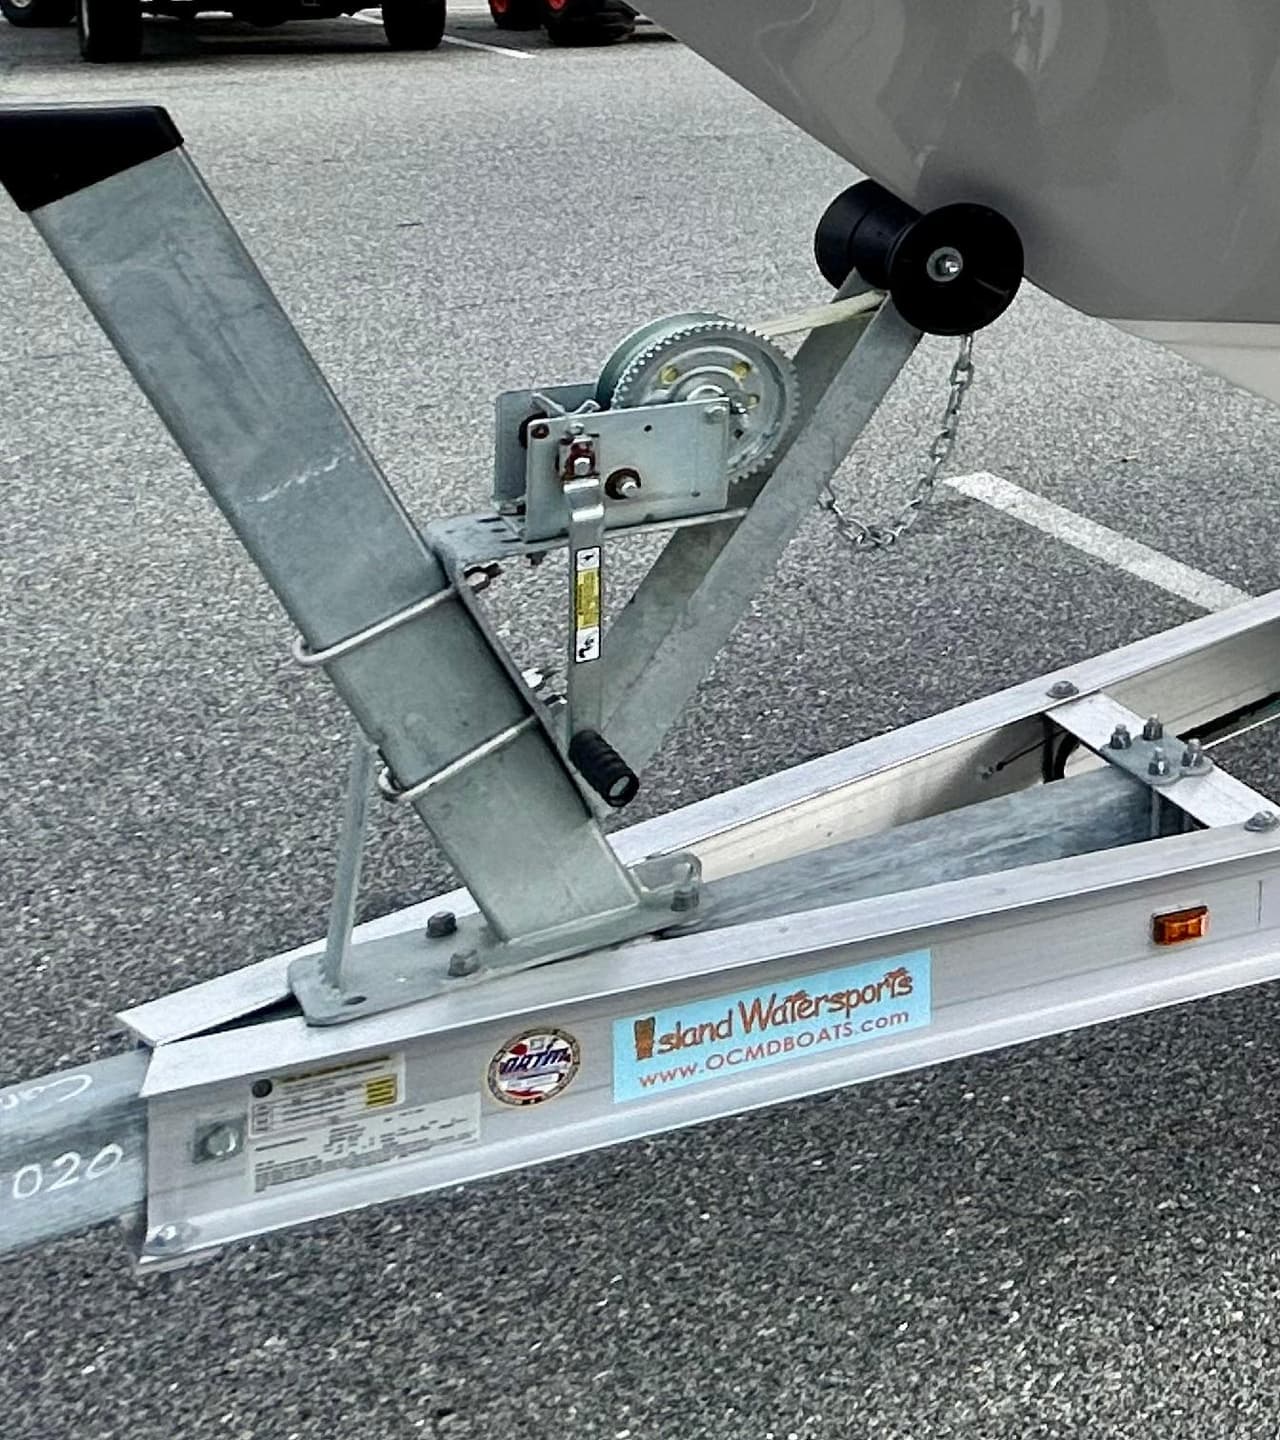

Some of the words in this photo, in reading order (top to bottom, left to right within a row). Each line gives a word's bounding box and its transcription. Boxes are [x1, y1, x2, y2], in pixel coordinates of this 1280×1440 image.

[633, 1009, 733, 1061] Island
[738, 966, 914, 1035] Watersports
[639, 1010, 910, 1088] www.OCMDBOATS.com
